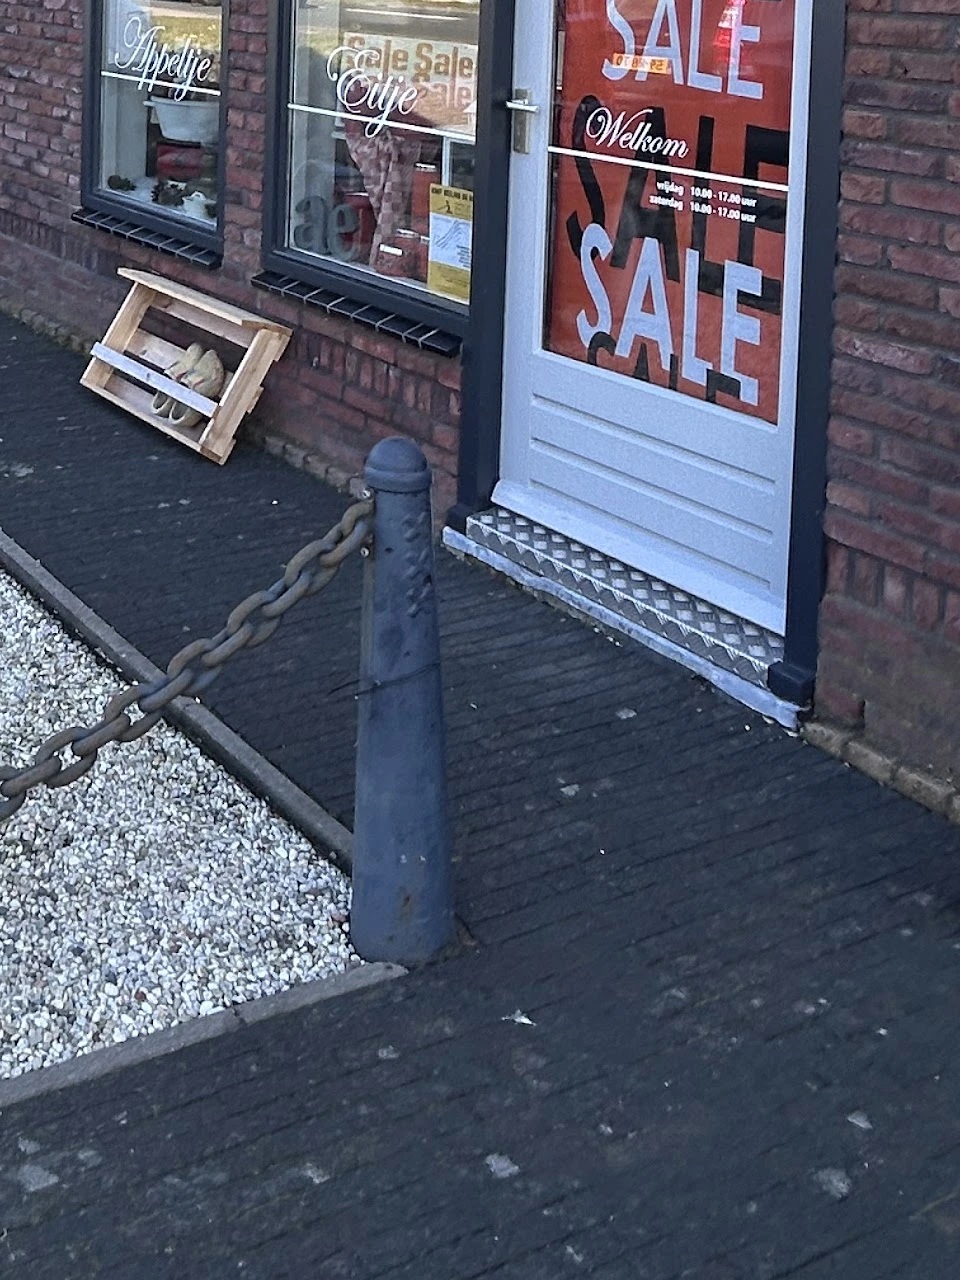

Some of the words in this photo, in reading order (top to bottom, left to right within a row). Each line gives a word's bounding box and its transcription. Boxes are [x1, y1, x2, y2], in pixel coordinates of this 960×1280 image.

[114, 16, 211, 102] Appeltje
[414, 42, 474, 80] Sale
[327, 45, 418, 139] Eitje
[585, 106, 689, 159] Welkom
[649, 195, 684, 211] zaterdag
[689, 201, 713, 215] 10.00
[718, 206, 741, 220] 17.00
[741, 213, 757, 223] uur
[656, 181, 685, 197] vrijdag
[690, 186, 713, 200] 10.00
[718, 191, 741, 205] 17.00
[741, 197, 758, 208] uur
[576, 222, 763, 406] SALE
